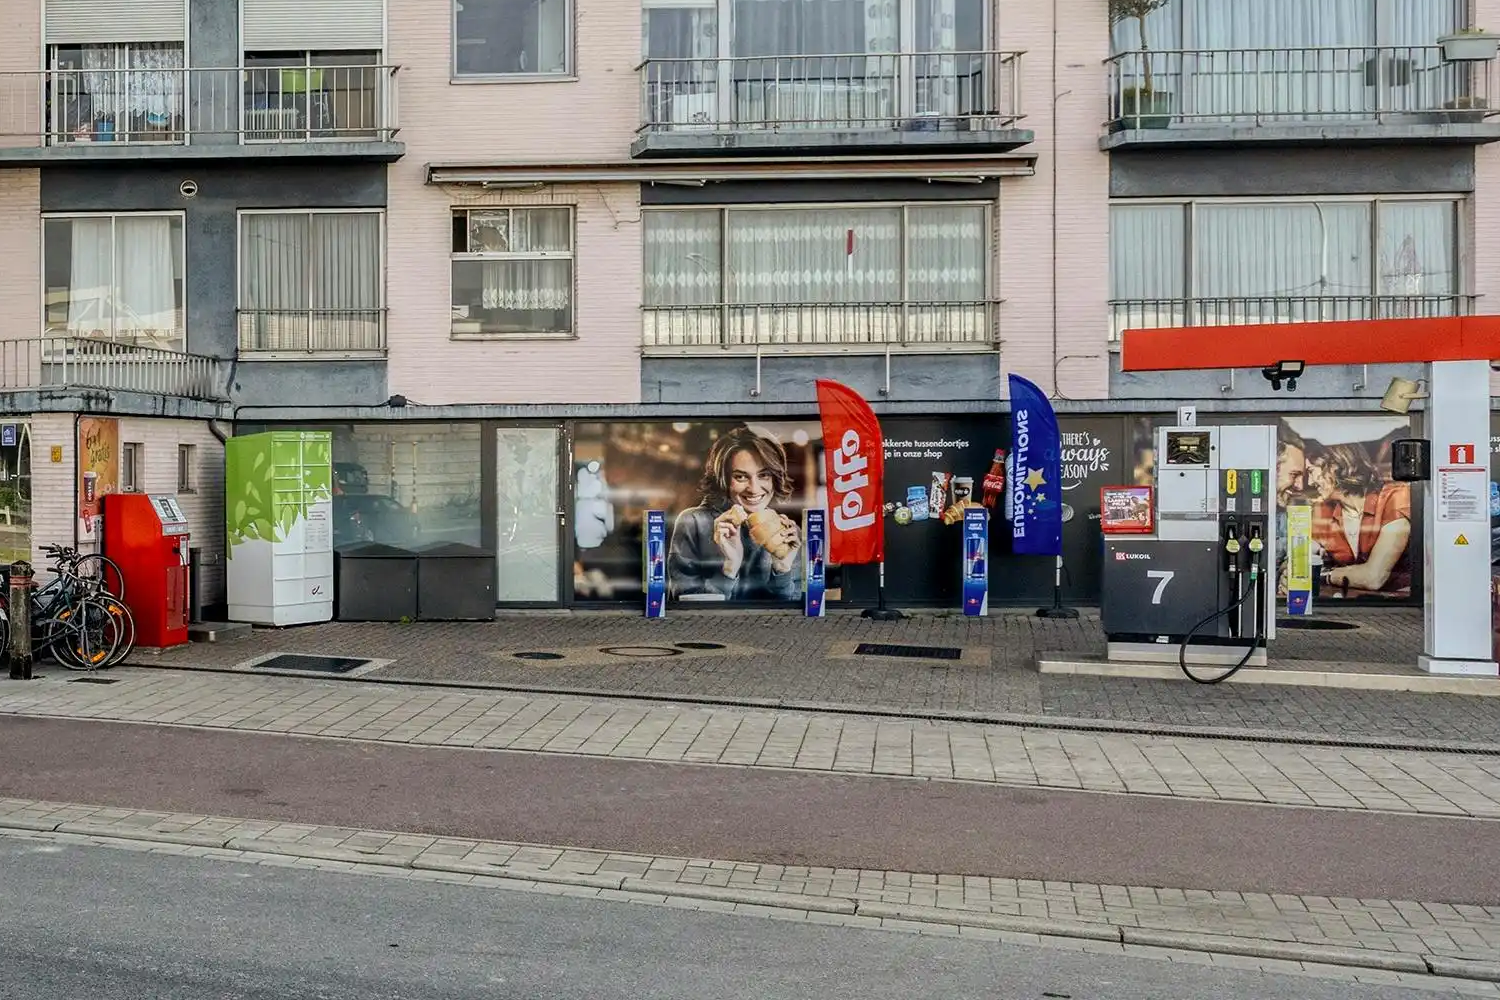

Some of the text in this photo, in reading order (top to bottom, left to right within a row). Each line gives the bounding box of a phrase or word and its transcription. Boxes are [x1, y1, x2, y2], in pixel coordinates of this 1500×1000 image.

[1184, 412, 1192, 421] 7
[914, 438, 970, 450] tussendoortjes
[1062, 431, 1090, 446] THERE'S
[893, 449, 902, 457] in
[923, 448, 943, 460] shop
[1147, 570, 1175, 604] 7
